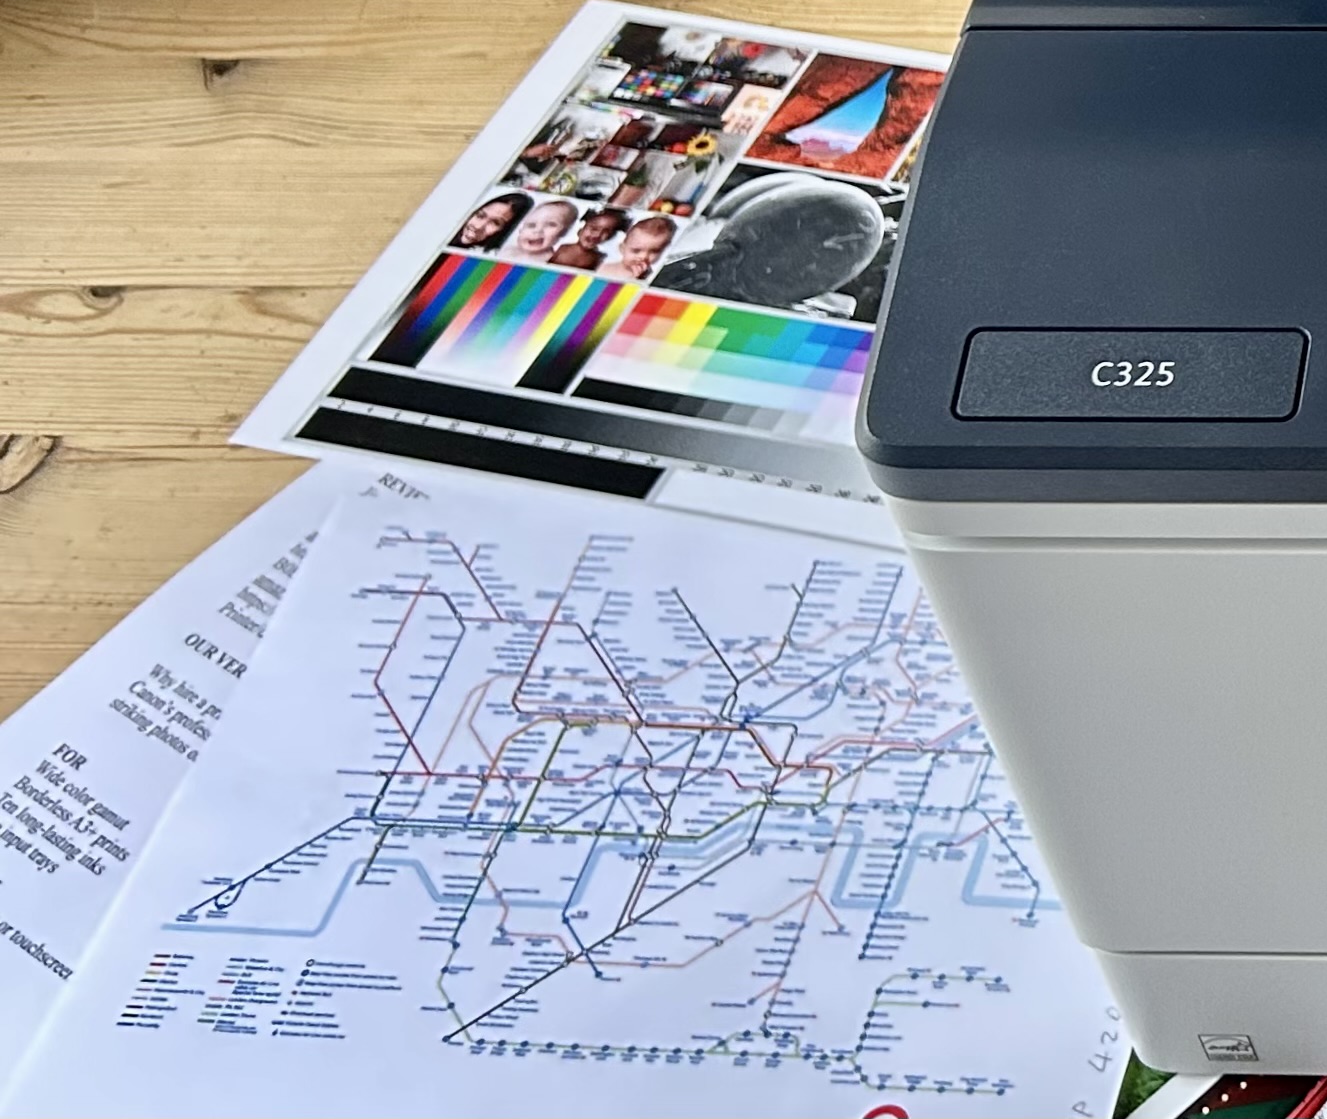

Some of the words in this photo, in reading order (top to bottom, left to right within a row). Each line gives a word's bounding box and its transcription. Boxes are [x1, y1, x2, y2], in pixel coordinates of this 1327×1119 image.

[1091, 361, 1176, 387] C325
[184, 633, 218, 660] OUR
[52, 743, 87, 771] FOR
[36, 759, 66, 787] Wide
[63, 782, 95, 807] color
[13, 775, 73, 822] Borderless
[90, 833, 130, 863] prints
[28, 845, 59, 874] trays
[78, 850, 106, 877] inks
